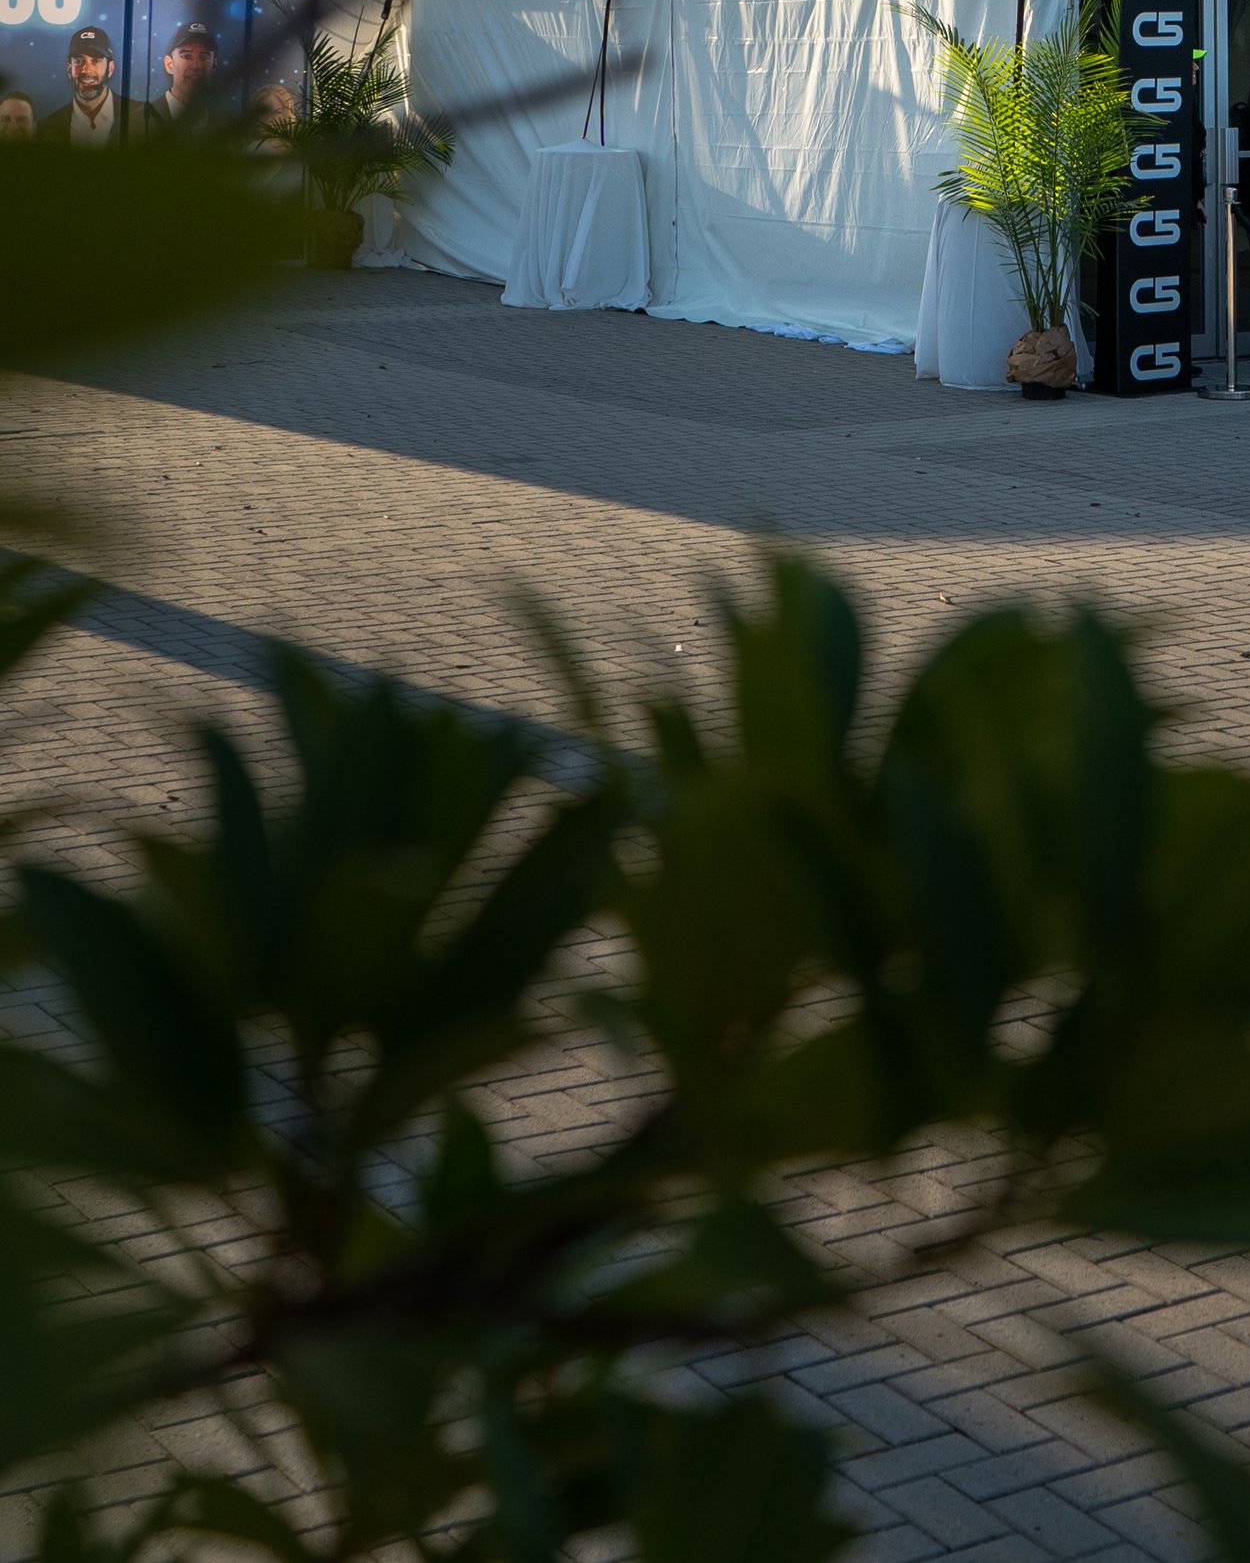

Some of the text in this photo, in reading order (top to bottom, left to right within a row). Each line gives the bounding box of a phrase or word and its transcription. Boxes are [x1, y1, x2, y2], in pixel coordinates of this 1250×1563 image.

[1132, 11, 1184, 47] C5
[1131, 77, 1183, 114] C5
[1130, 143, 1182, 181] C5
[1130, 209, 1181, 247] C5
[1130, 276, 1181, 314] C5
[1130, 342, 1181, 380] C5
